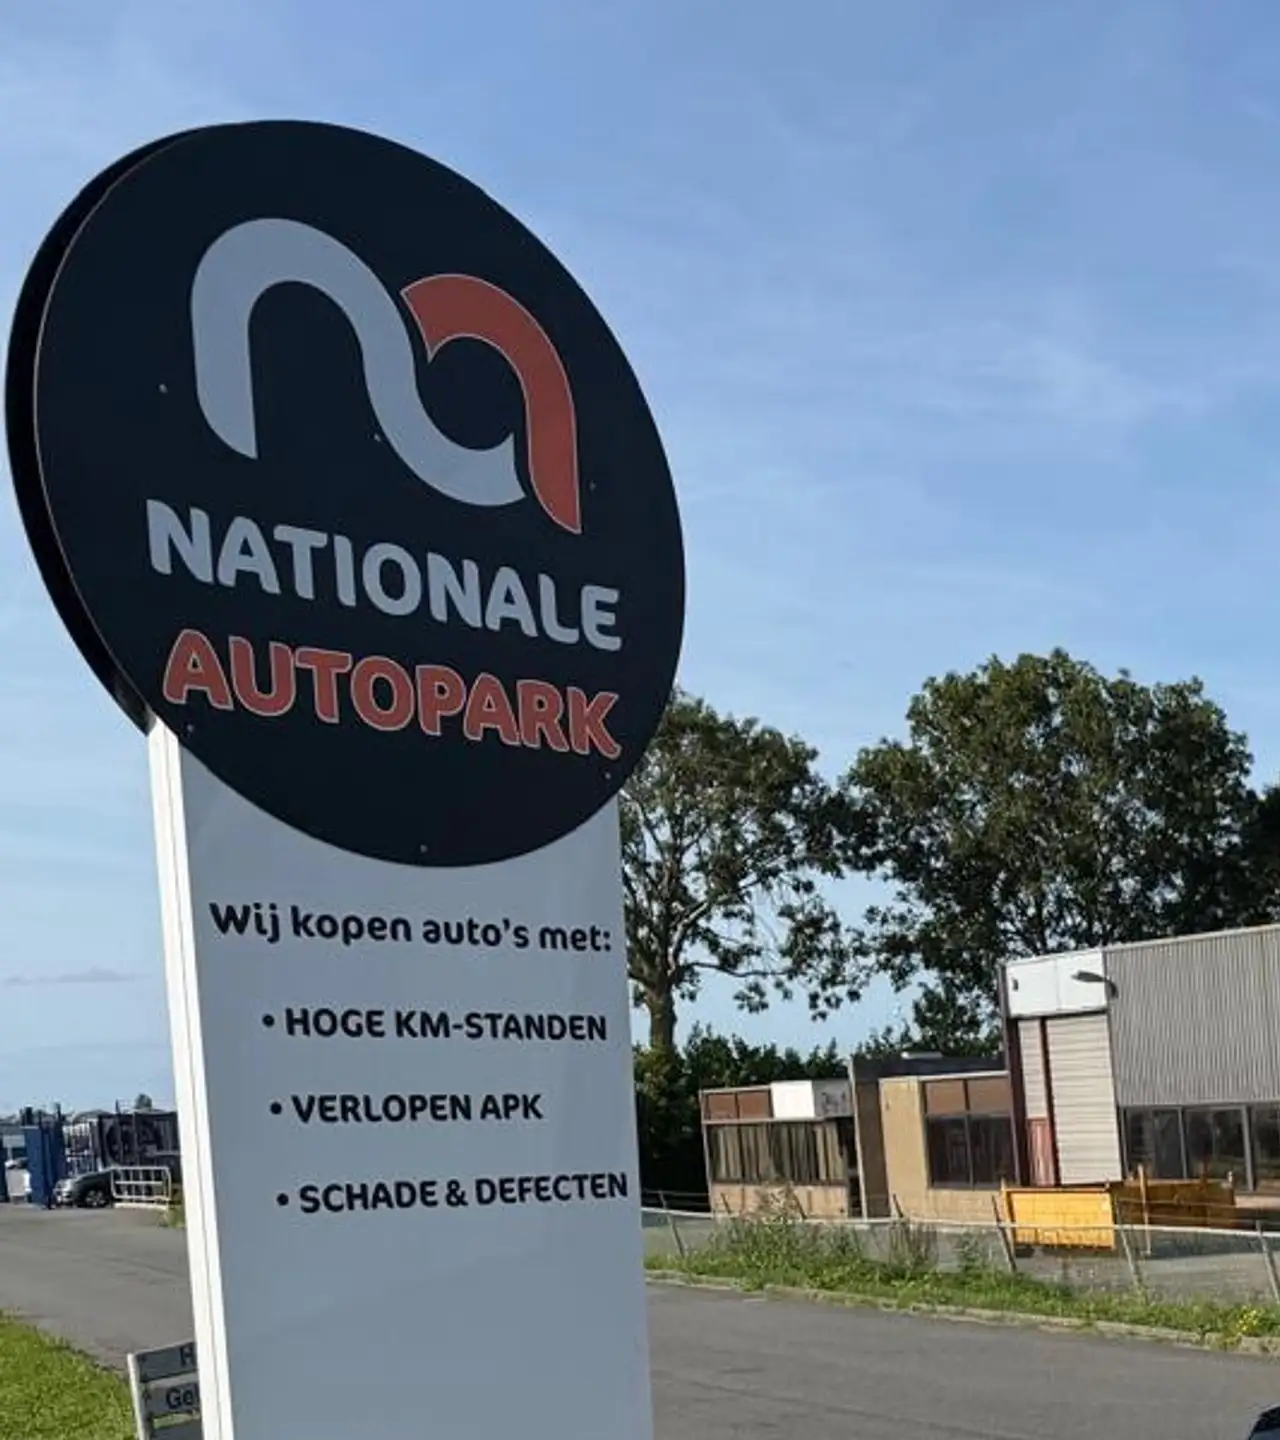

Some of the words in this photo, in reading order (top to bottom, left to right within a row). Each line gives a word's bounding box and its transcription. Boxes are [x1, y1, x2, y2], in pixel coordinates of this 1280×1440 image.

[145, 498, 622, 651] NATIONALE
[162, 628, 621, 760] AUTOPARK
[208, 901, 281, 944] Wij
[290, 904, 413, 947] kopen
[422, 917, 530, 950] auto's
[538, 924, 612, 952] met:
[284, 1007, 386, 1038] HOGE
[395, 1009, 608, 1041] KM-STANDEN
[291, 1093, 473, 1123] VERLOPEN
[479, 1093, 544, 1121] APK
[299, 1179, 439, 1213] SCHADE
[445, 1178, 469, 1207] &
[475, 1171, 629, 1205] DEFECTEN
